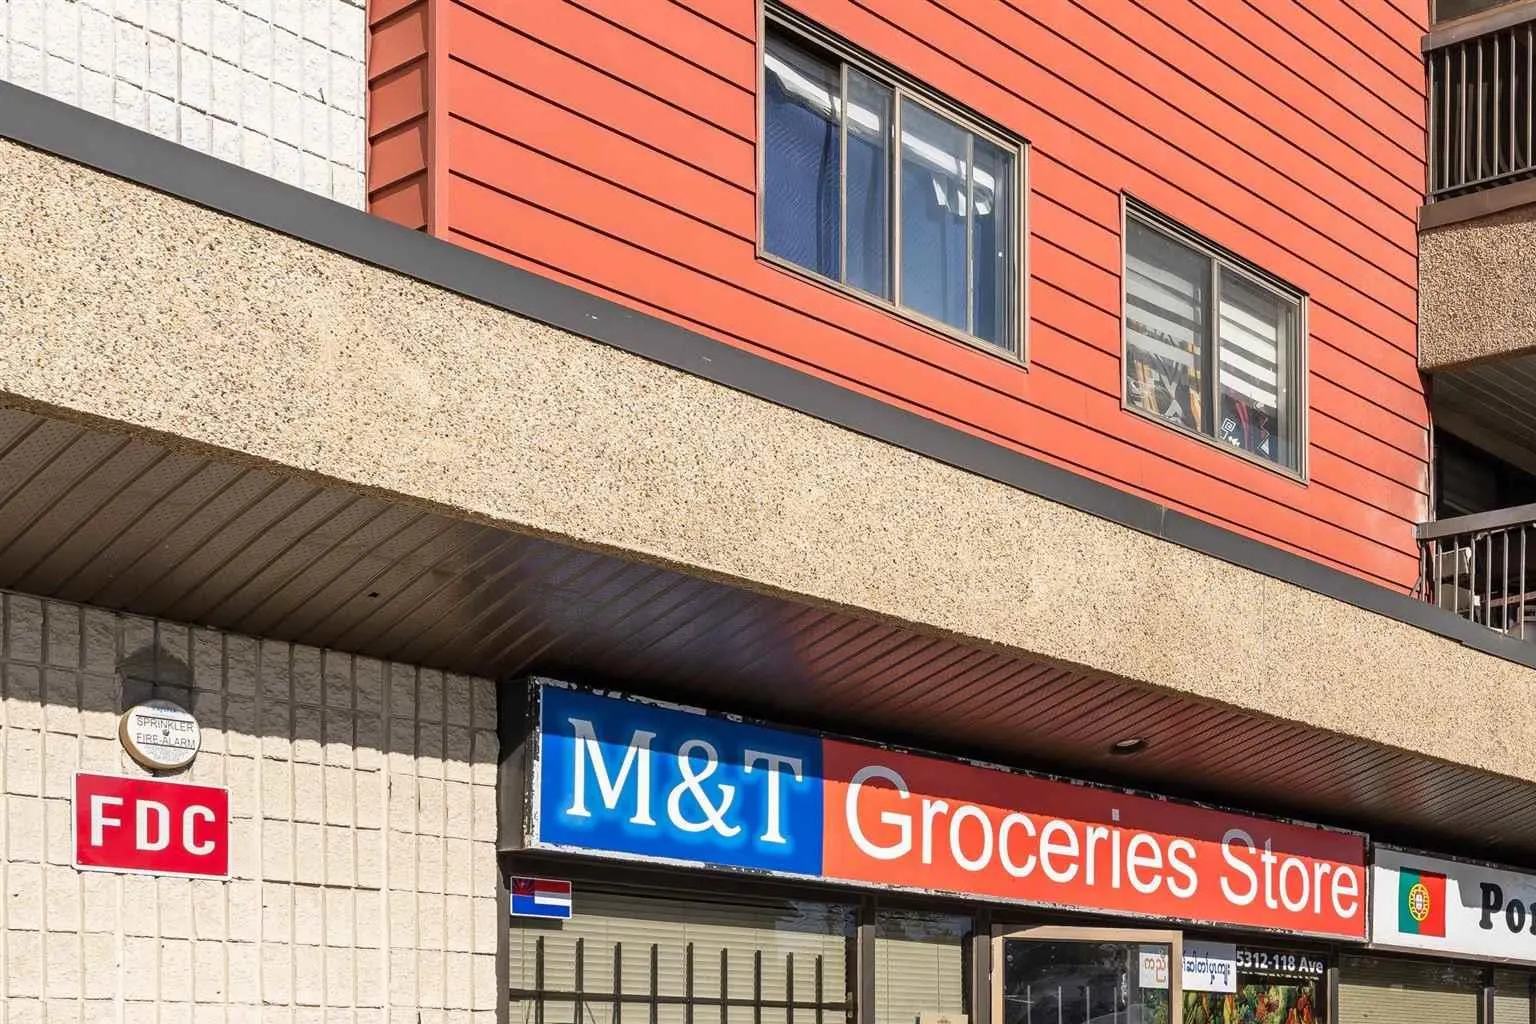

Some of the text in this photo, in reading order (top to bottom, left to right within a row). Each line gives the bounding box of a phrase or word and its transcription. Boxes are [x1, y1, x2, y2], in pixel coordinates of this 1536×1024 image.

[136, 716, 194, 732] SPRINKLER
[566, 717, 803, 844] M&T
[90, 794, 216, 856] FDC
[846, 765, 1358, 918] Groceries Store
[1236, 951, 1324, 974] 5312-118 Ave
